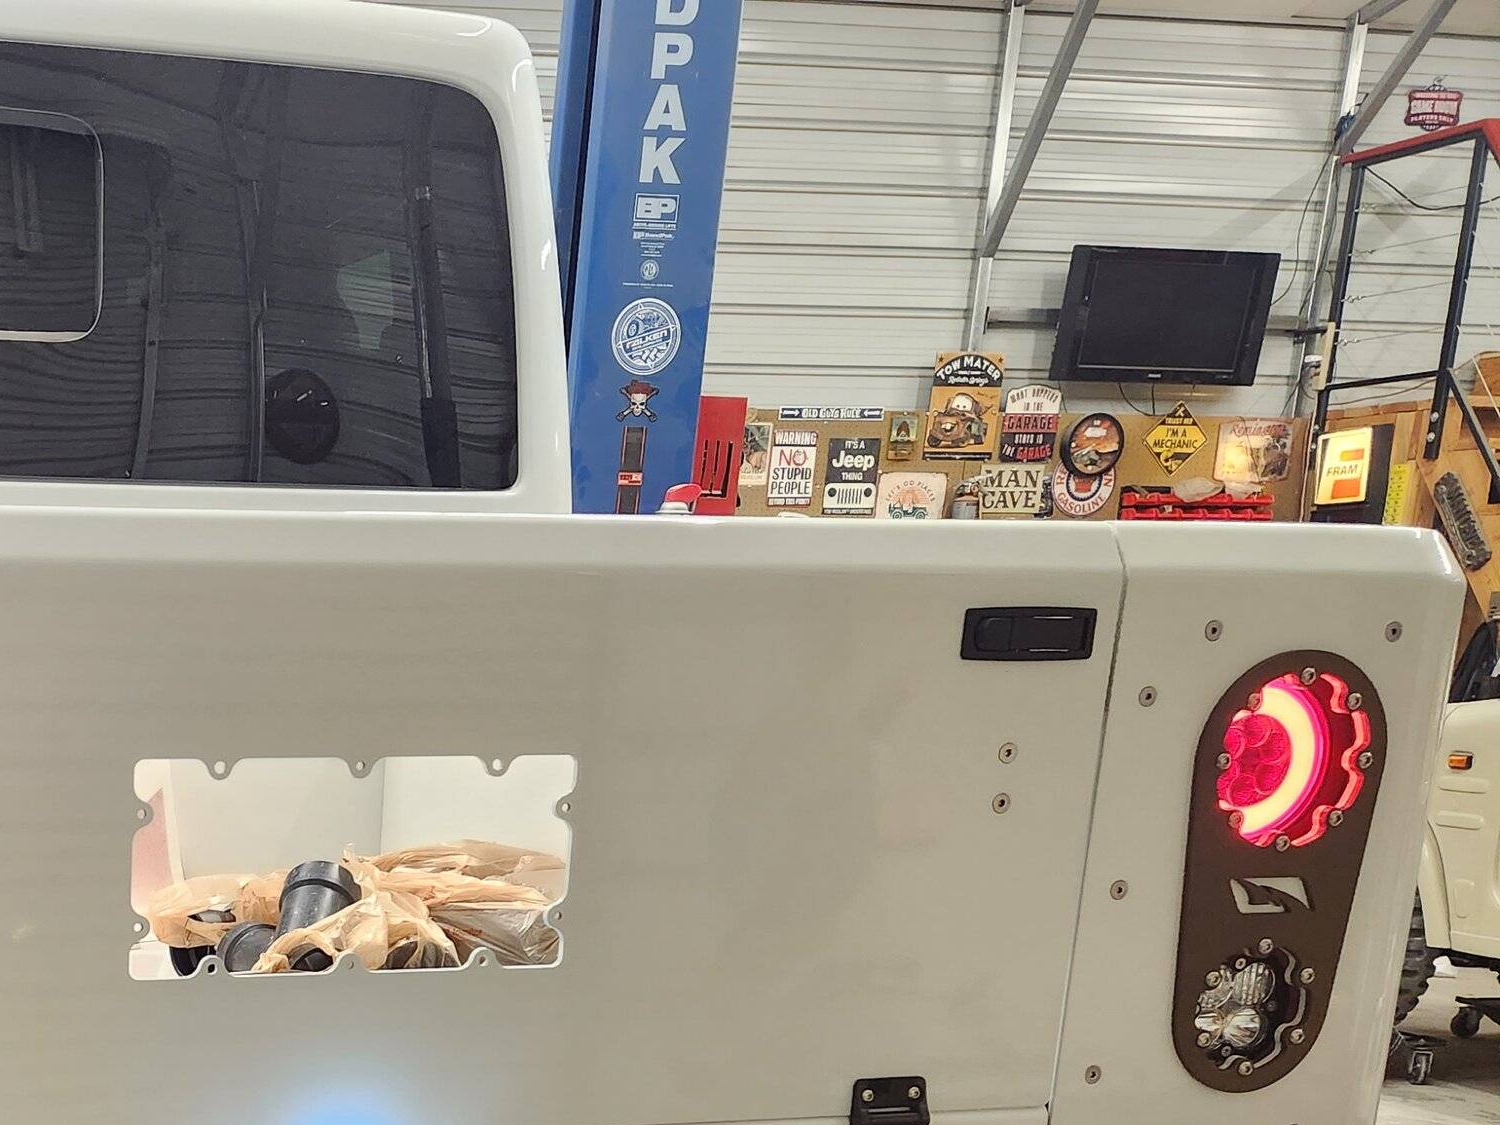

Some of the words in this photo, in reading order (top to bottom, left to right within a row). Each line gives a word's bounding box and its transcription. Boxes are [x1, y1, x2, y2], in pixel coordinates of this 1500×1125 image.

[936, 358, 961, 380] TOW
[963, 355, 1001, 381] MATER
[802, 408, 819, 418] OLD
[1007, 415, 1053, 430] GARAGE
[775, 431, 817, 446] WARNING
[1165, 428, 1179, 438] I'M
[1180, 428, 1187, 438] A
[845, 440, 859, 449] IT'S
[859, 440, 866, 449] A
[1152, 439, 1198, 449] MECHANIC
[779, 448, 807, 467] NO
[1016, 444, 1052, 460] GARAGE
[832, 450, 875, 471] Jeep
[772, 467, 812, 480] STUPID
[841, 472, 863, 481] THING
[1326, 463, 1359, 477] FRAM
[983, 469, 1041, 488] MAN
[770, 481, 811, 495] PEOPLE
[982, 490, 1037, 509] CAVE
[1057, 492, 1107, 514] GASOLINE
